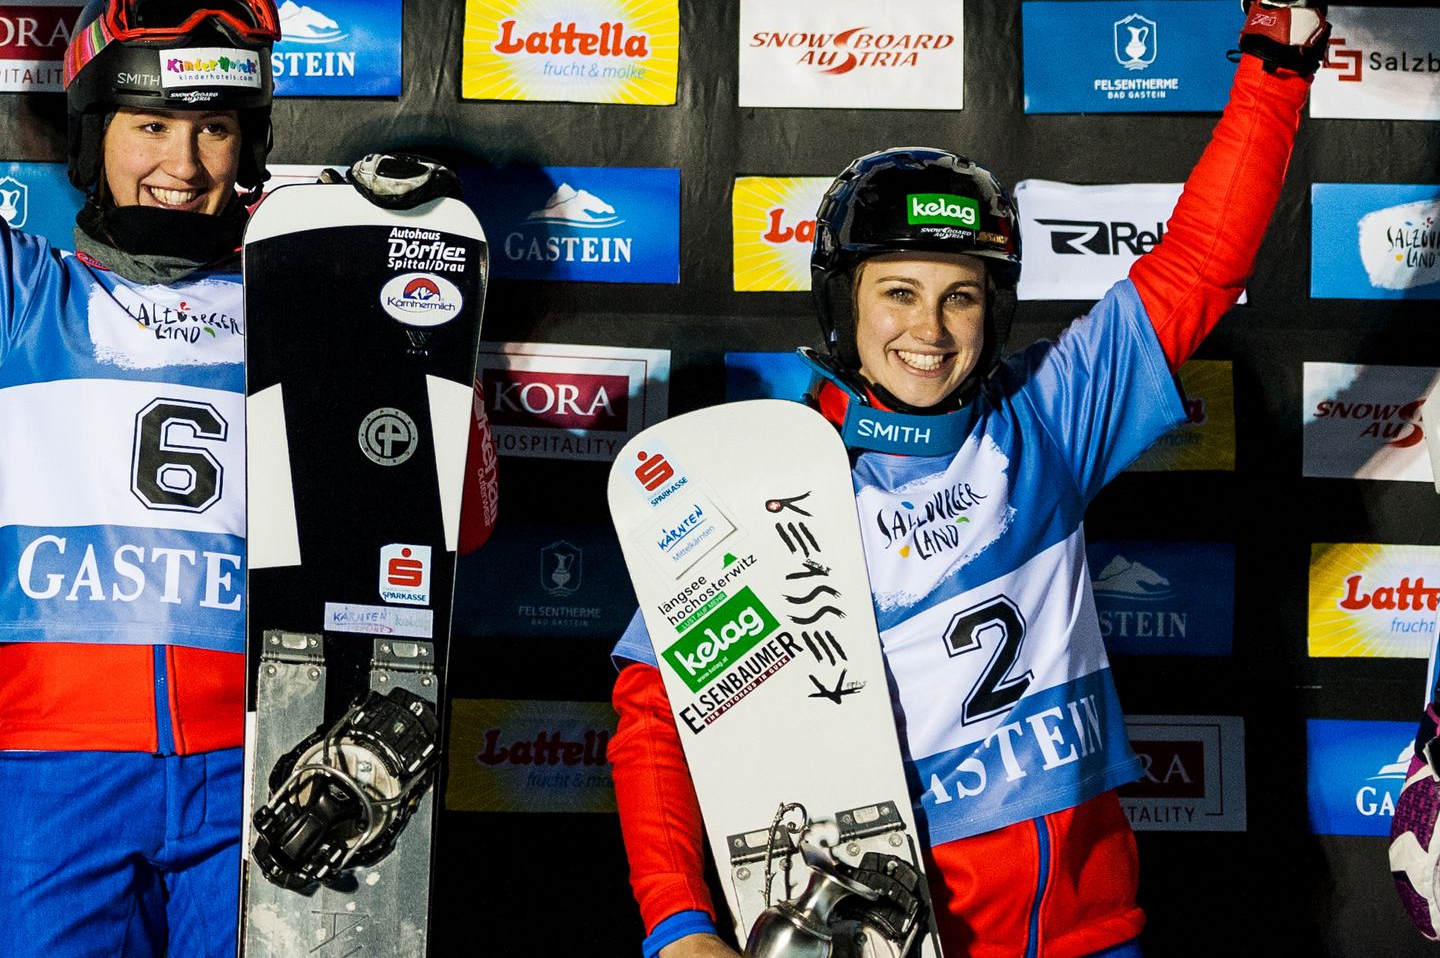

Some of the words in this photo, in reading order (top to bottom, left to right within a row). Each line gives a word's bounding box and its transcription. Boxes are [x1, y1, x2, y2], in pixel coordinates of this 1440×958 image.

[494, 20, 648, 58] Lattella
[749, 29, 954, 49] SNOWBOARD
[117, 72, 160, 86] SMITH
[543, 61, 585, 79] frucht
[588, 63, 599, 78] &
[603, 63, 646, 80] molke
[1094, 78, 1179, 91] FELSENTHERME
[1108, 91, 1125, 99] BAD
[1128, 91, 1167, 99] GASTEIN
[912, 197, 976, 225] kelag
[389, 227, 441, 241] Autohaus
[504, 231, 632, 264] GASTEIN
[388, 238, 466, 262] Dörfler
[387, 257, 465, 273] Spittal/Drau
[492, 381, 617, 418] KORA
[857, 418, 931, 444] SMITH
[130, 396, 229, 514] 6
[650, 476, 689, 507] SPARKASSE
[914, 524, 959, 561] LAND
[17, 534, 242, 611] GASTE
[382, 591, 427, 602] SPARKASSE
[658, 575, 707, 615] längsee
[667, 554, 758, 626] hochosterwitz
[518, 605, 602, 619] FELSENTHERME
[1391, 617, 1434, 633] frucht
[674, 606, 765, 676] kelag
[942, 594, 1035, 727] 2
[679, 631, 804, 735] ELSENBAUMER
[721, 680, 758, 712] AUTOHAUS
[758, 673, 768, 683] IN
[768, 656, 788, 674] GURK
